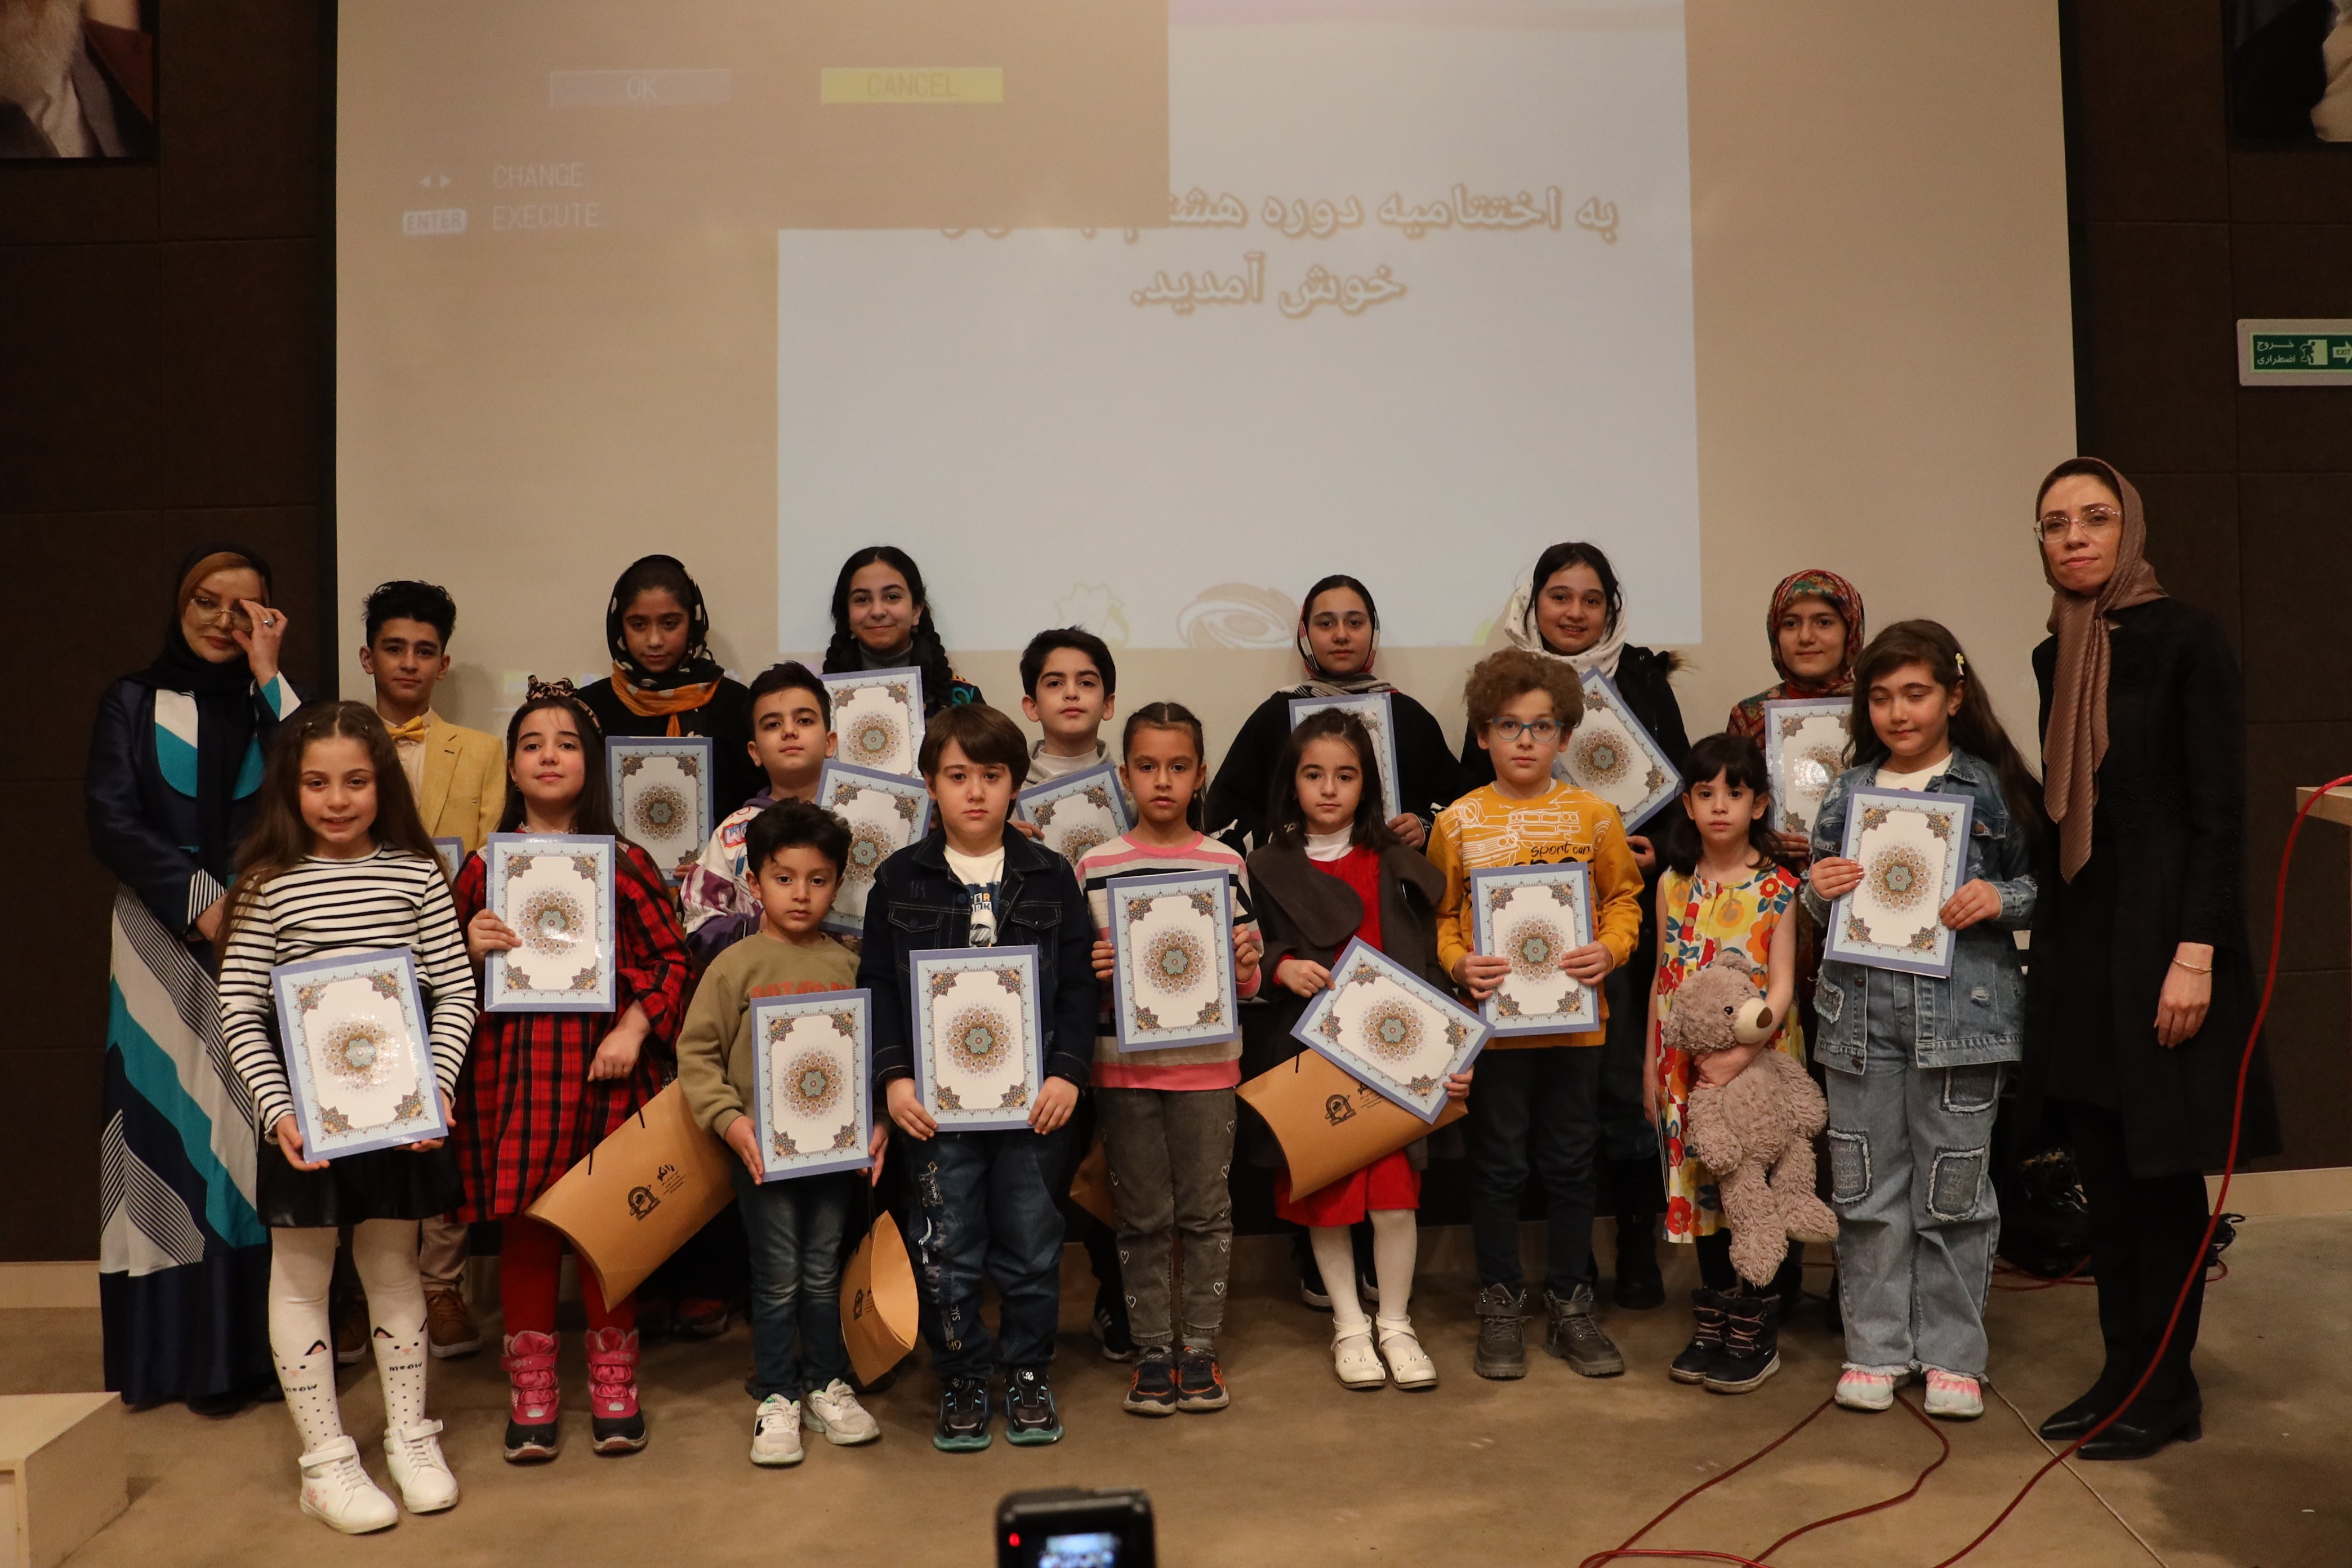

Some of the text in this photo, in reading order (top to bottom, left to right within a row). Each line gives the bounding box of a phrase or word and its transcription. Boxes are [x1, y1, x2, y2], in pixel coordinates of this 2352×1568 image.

[627, 75, 657, 100] OK
[867, 73, 959, 97] CANCEL
[492, 162, 584, 189] CHANGE
[492, 202, 599, 230] EXECUTE
[1262, 195, 1364, 240] دوره
[1378, 183, 1562, 240] اختتامیه
[1576, 197, 1619, 244] به
[1278, 264, 1406, 319] خوش
[2257, 354, 2296, 365] اضطراری
[389, 1362, 422, 1371] meow
[283, 1384, 317, 1392] meow
